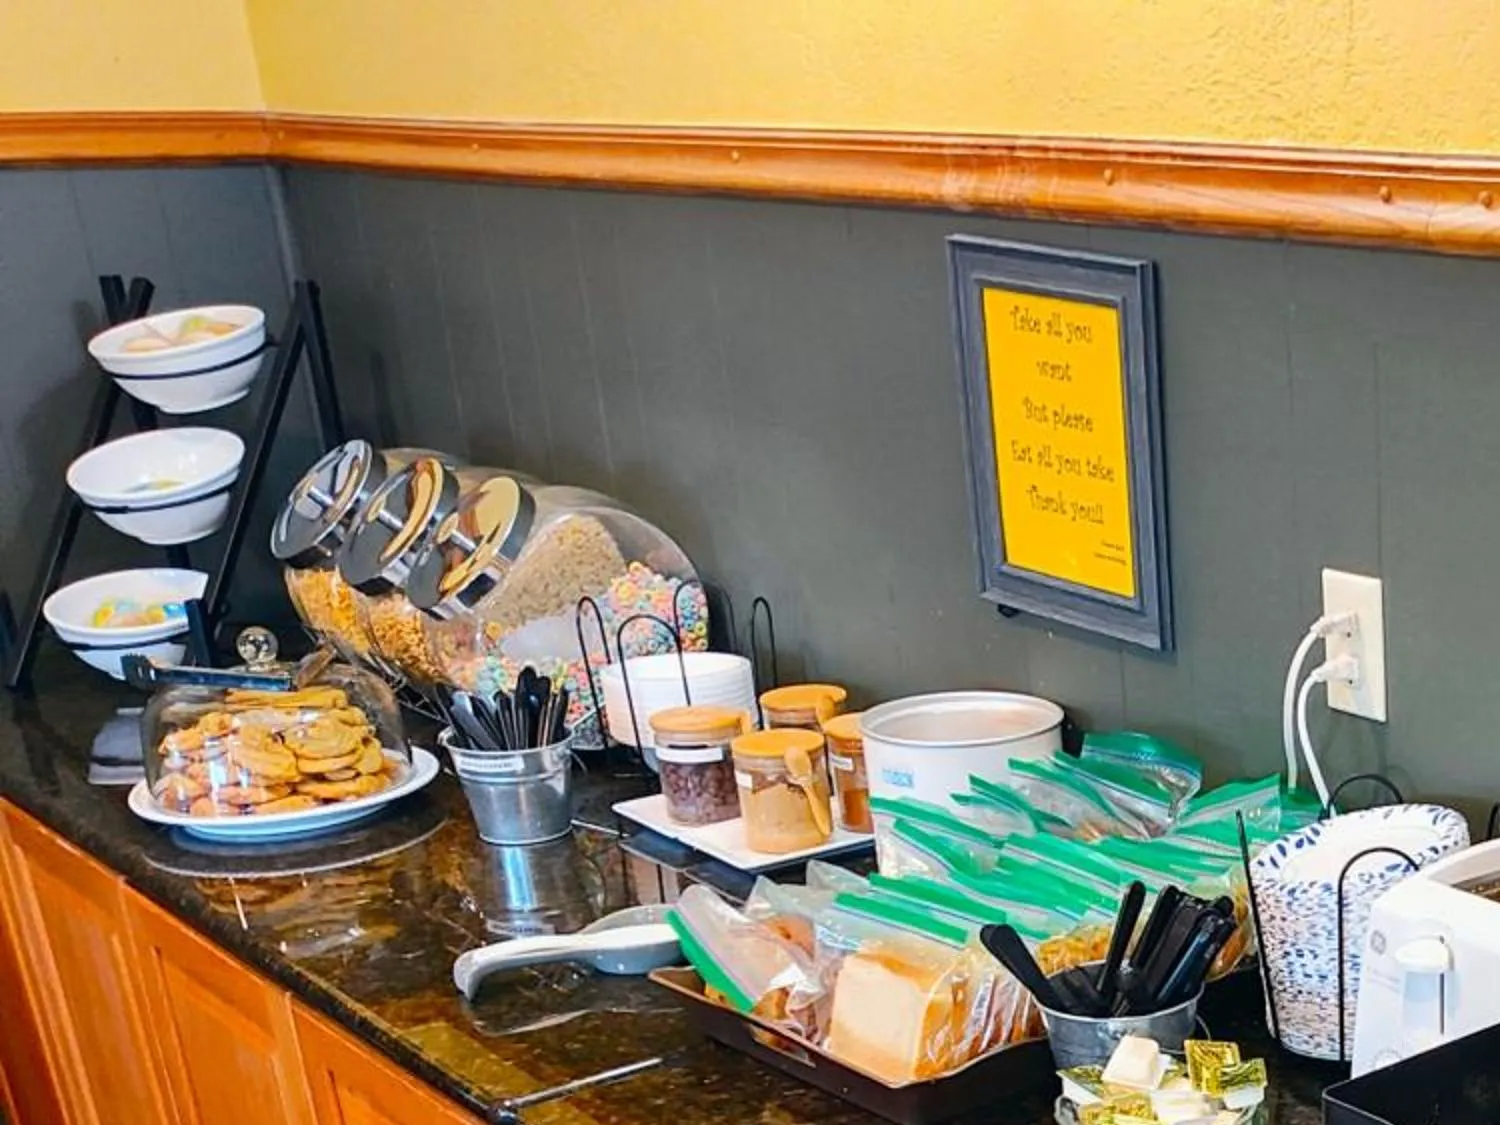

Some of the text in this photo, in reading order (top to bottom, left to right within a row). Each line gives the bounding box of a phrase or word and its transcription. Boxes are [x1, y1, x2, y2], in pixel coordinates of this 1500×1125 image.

[1009, 304, 1093, 345] Take all you
[1036, 360, 1072, 382] want
[1023, 396, 1093, 433] But please
[1011, 440, 1033, 463] Eat
[1037, 444, 1053, 469] all
[1056, 453, 1082, 477] you
[1025, 484, 1067, 515] Thank
